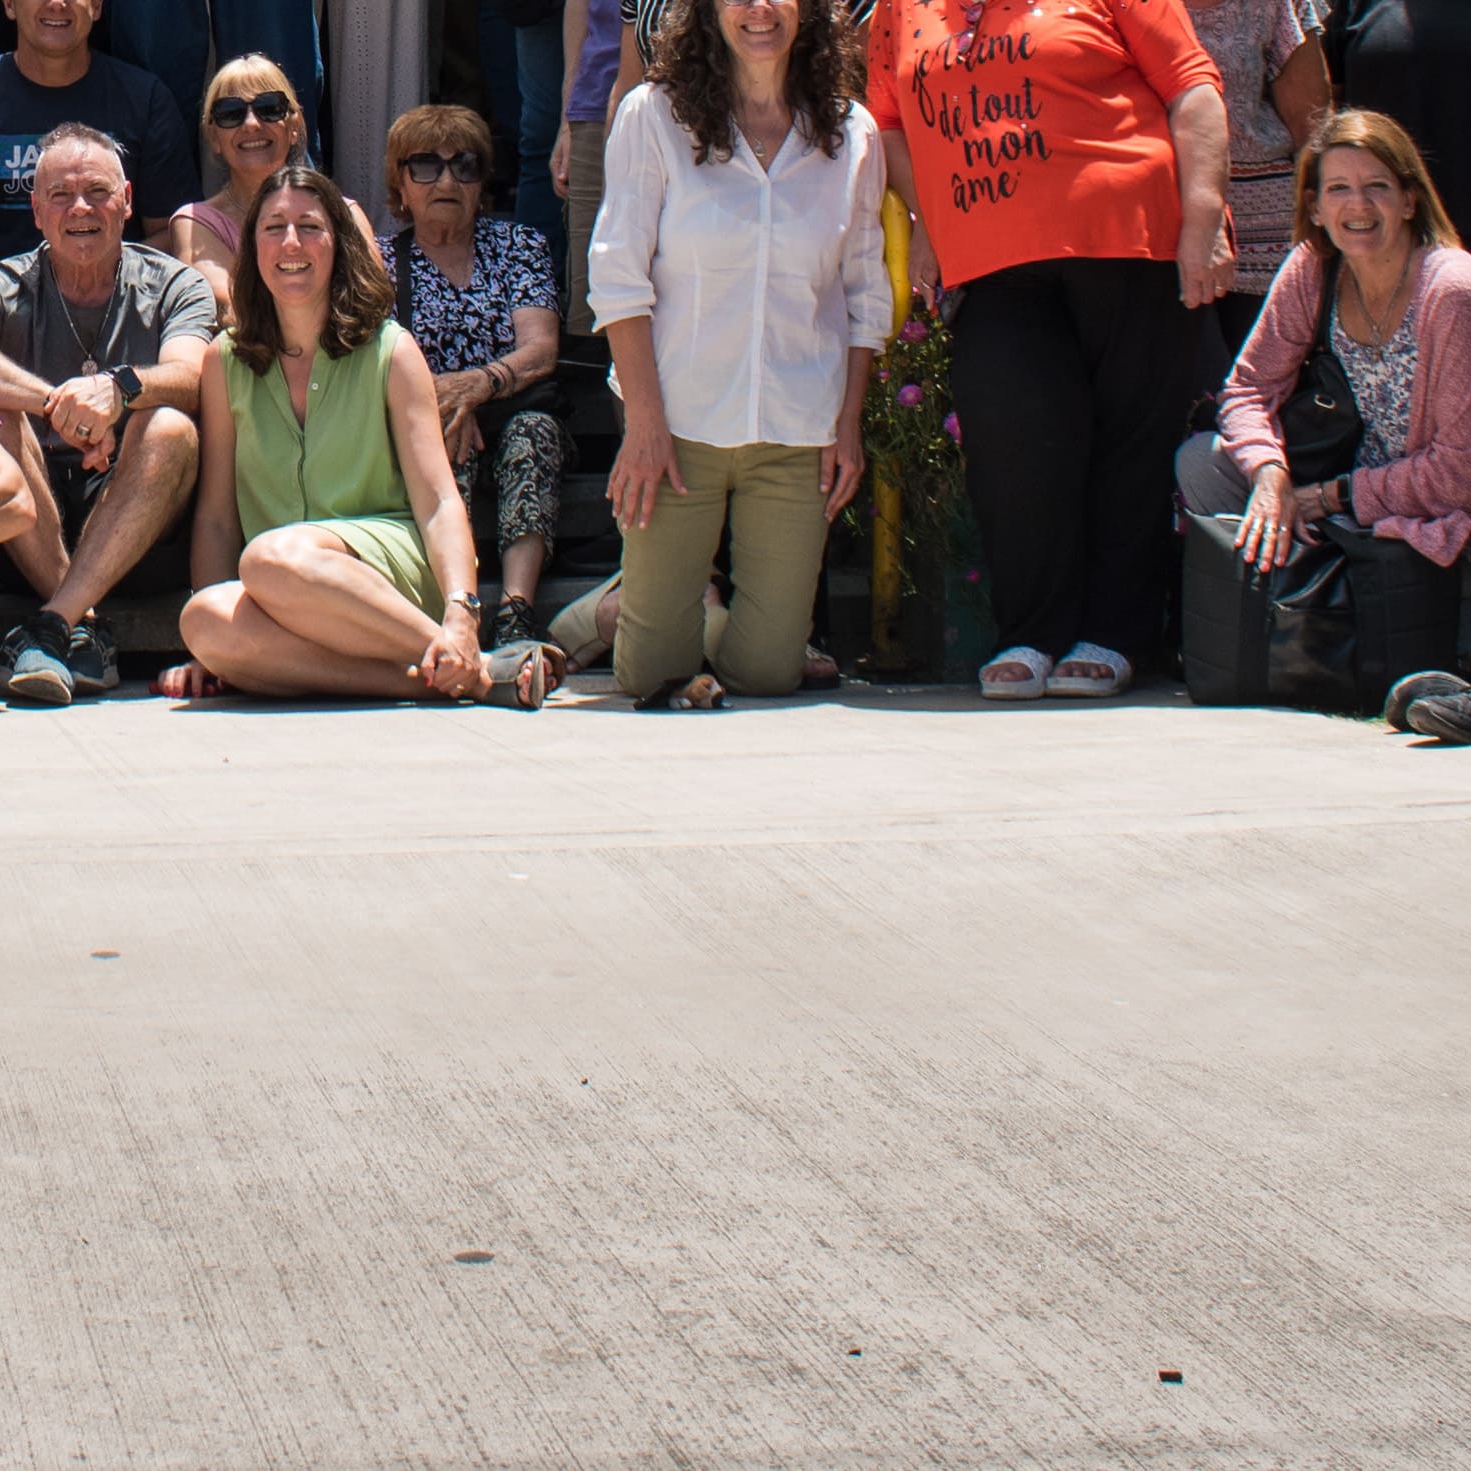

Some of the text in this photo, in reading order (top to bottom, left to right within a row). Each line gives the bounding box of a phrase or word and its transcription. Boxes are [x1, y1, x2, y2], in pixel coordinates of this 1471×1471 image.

[912, 48, 936, 128] je
[939, 77, 1043, 143] de tout
[5, 144, 39, 169] JA
[962, 130, 1053, 168] mon
